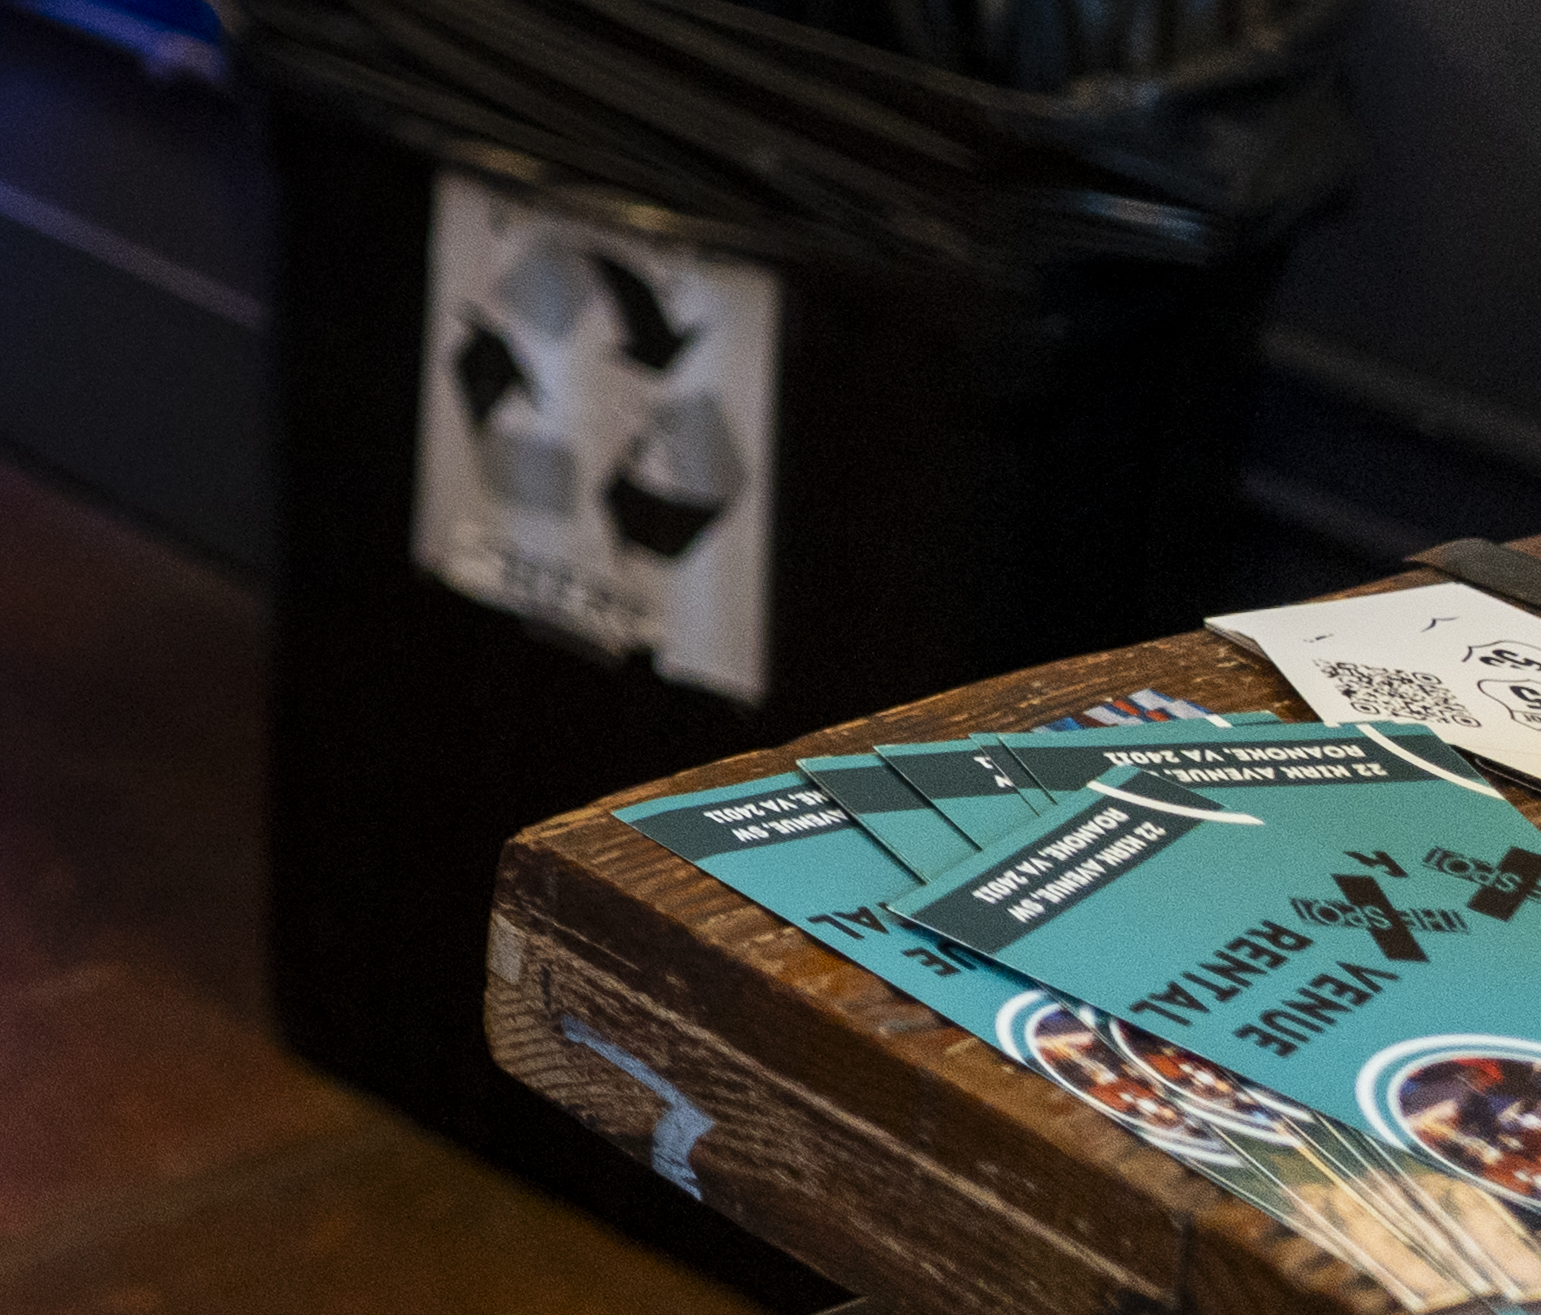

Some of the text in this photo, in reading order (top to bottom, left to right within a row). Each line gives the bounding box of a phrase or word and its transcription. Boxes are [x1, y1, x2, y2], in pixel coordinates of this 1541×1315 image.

[1180, 749, 1225, 763] VA
[1222, 744, 1367, 762] ROANOKE,
[1162, 765, 1276, 783] AVENUE,
[1279, 763, 1348, 780] KIRK
[1360, 762, 1388, 777] 22
[702, 802, 767, 824] 24011
[731, 824, 770, 843] SW
[1133, 820, 1166, 841] 22
[972, 807, 1131, 905] ROANOKE, VA 24011
[1094, 835, 1148, 867] KIRK
[1007, 898, 1047, 923] SW
[1128, 919, 1314, 1027] RENTAL
[1232, 961, 1402, 1058] VENUE
